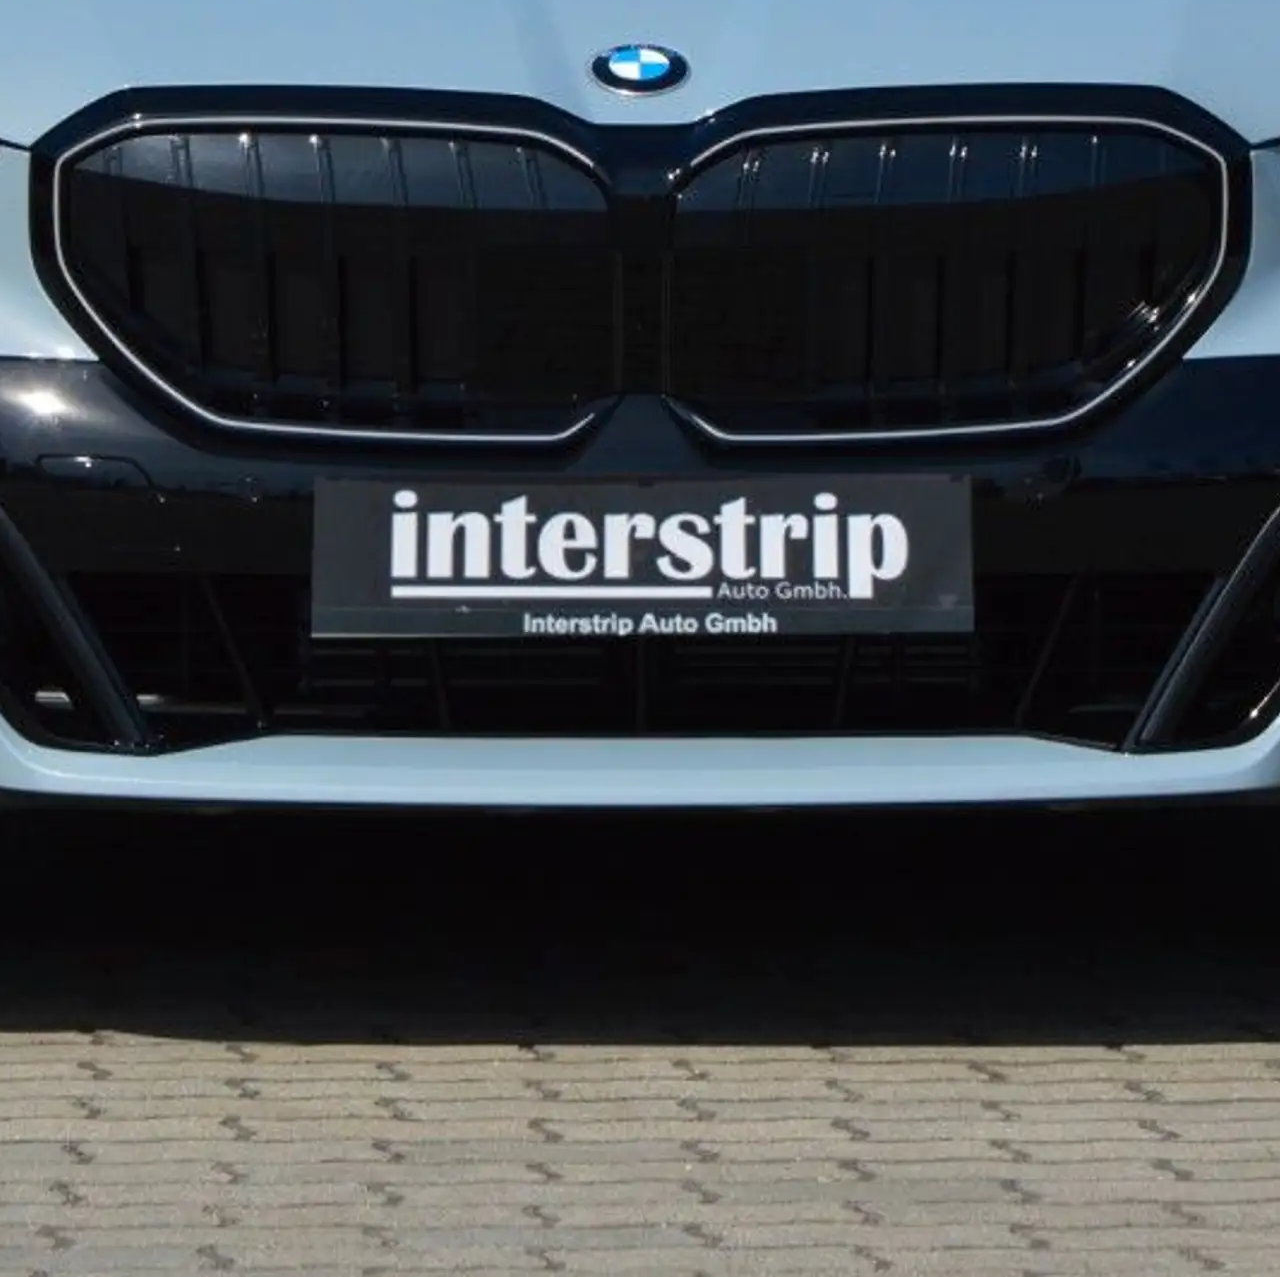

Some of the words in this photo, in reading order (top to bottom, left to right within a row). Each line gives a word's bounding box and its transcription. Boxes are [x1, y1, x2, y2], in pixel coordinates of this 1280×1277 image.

[390, 489, 909, 599] interstrip
[717, 581, 770, 600] Auto
[523, 612, 632, 635] Interstrip
[639, 613, 699, 634] Auto
[705, 612, 778, 634] Gmbh
